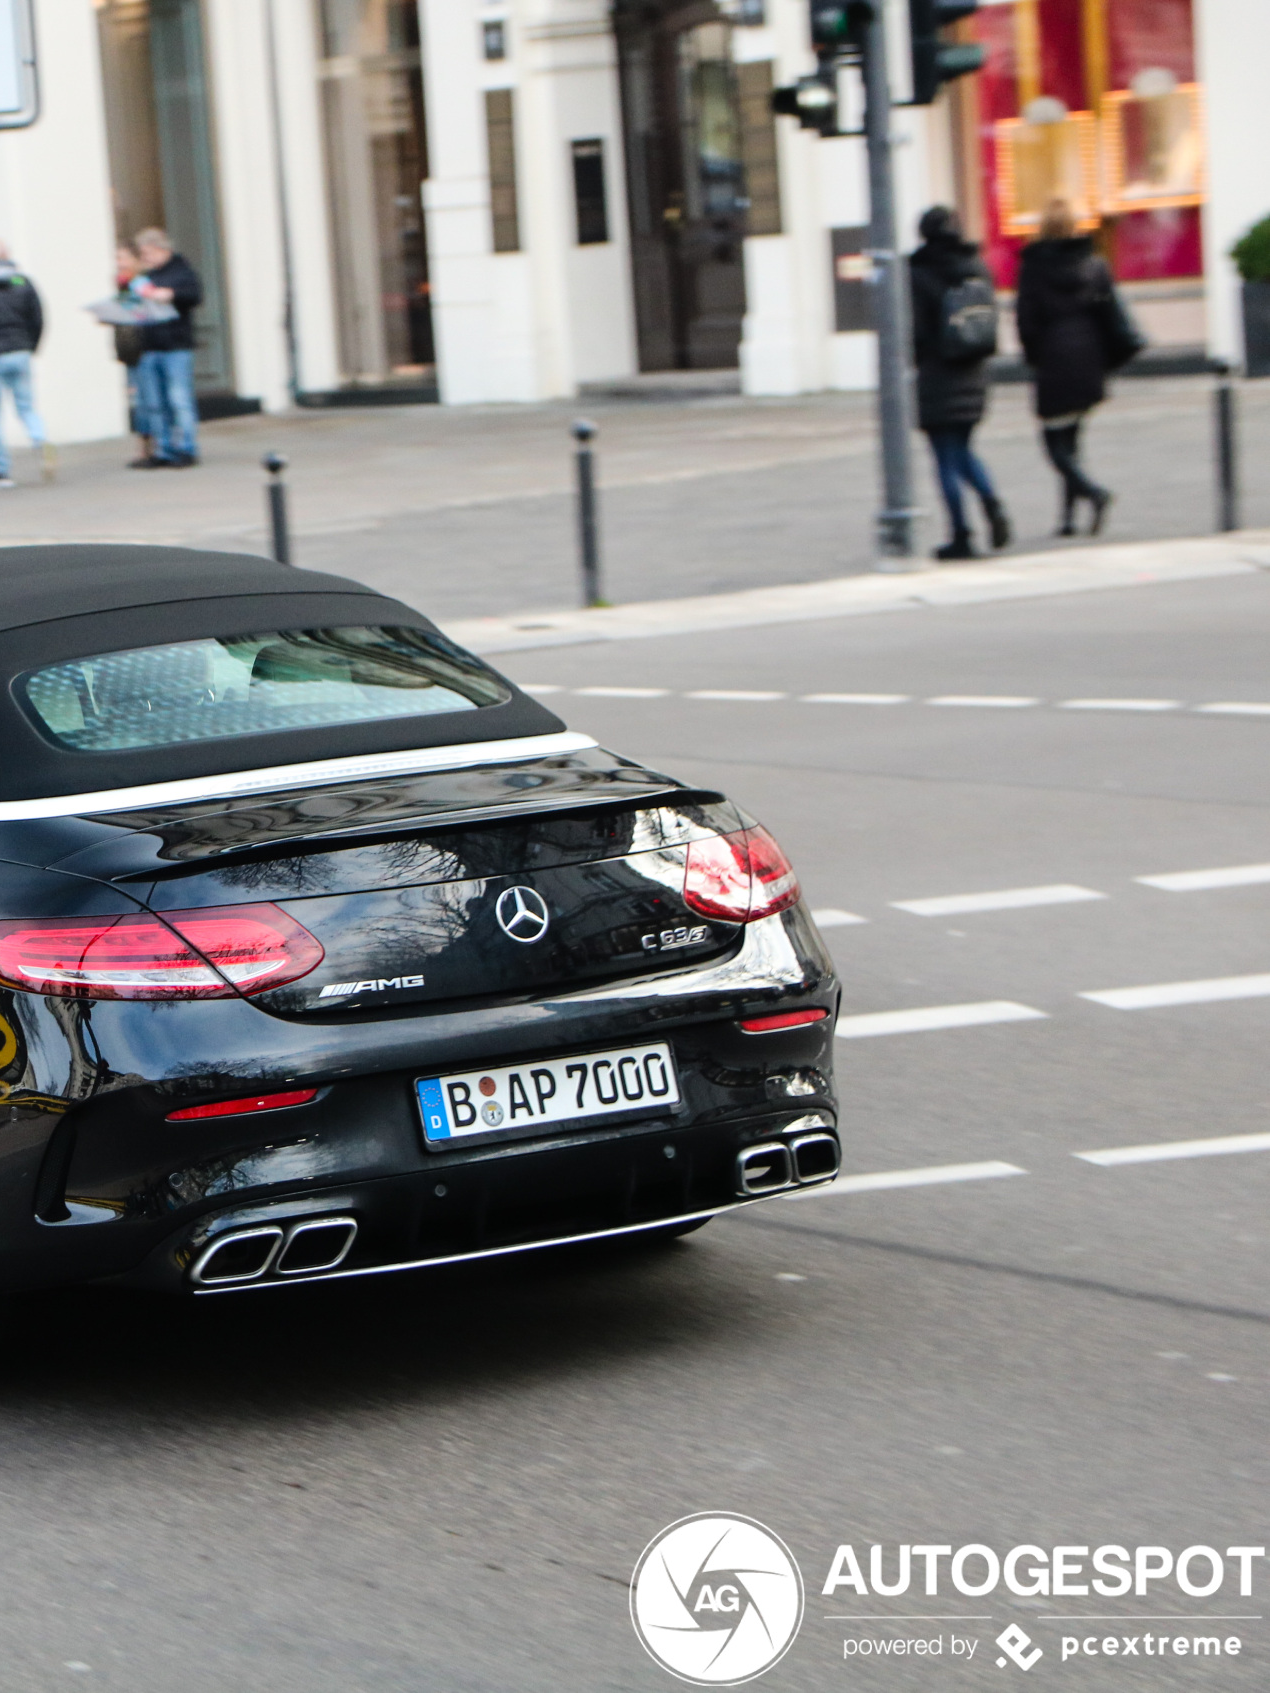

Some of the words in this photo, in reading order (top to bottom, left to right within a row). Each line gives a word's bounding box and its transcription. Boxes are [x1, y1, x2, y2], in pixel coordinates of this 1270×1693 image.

[352, 974, 425, 995] AMG
[446, 1080, 478, 1129] B
[508, 1067, 557, 1120] AP
[565, 1052, 670, 1109] 7000
[430, 1114, 443, 1130] D
